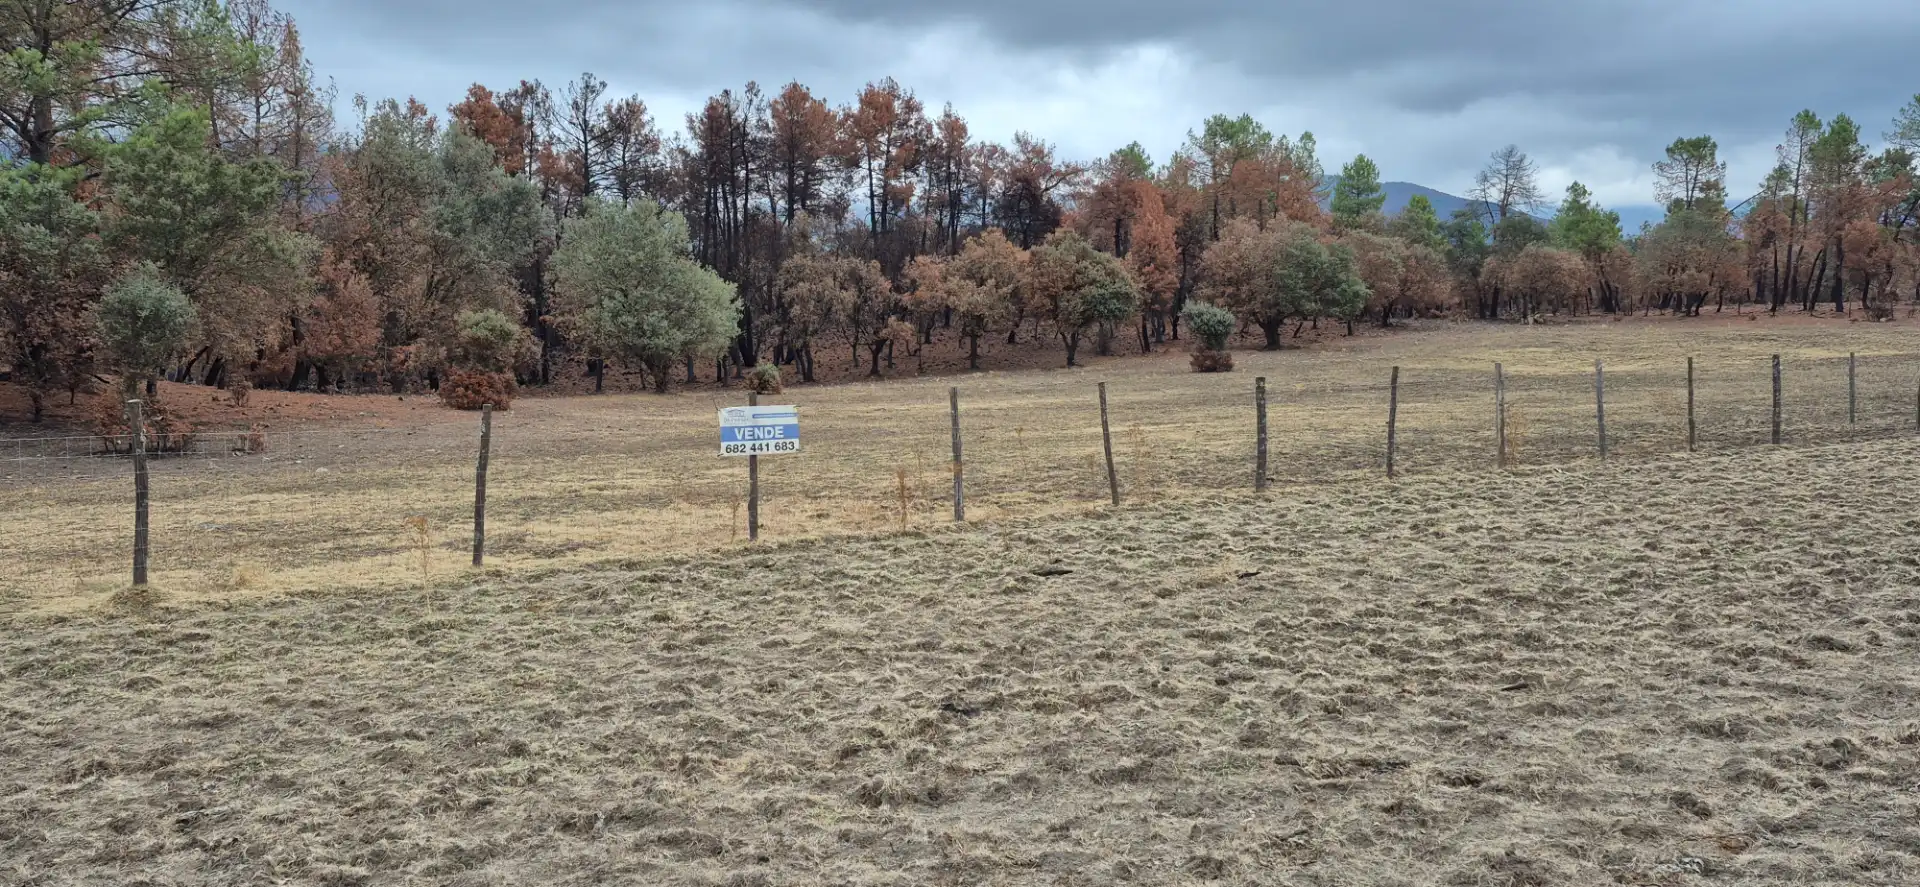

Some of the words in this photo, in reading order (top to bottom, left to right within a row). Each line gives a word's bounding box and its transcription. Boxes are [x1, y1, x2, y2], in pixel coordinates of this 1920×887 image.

[734, 426, 784, 440] VENDE
[725, 444, 746, 453] 682
[750, 442, 770, 452] 441
[774, 441, 795, 451] 683
